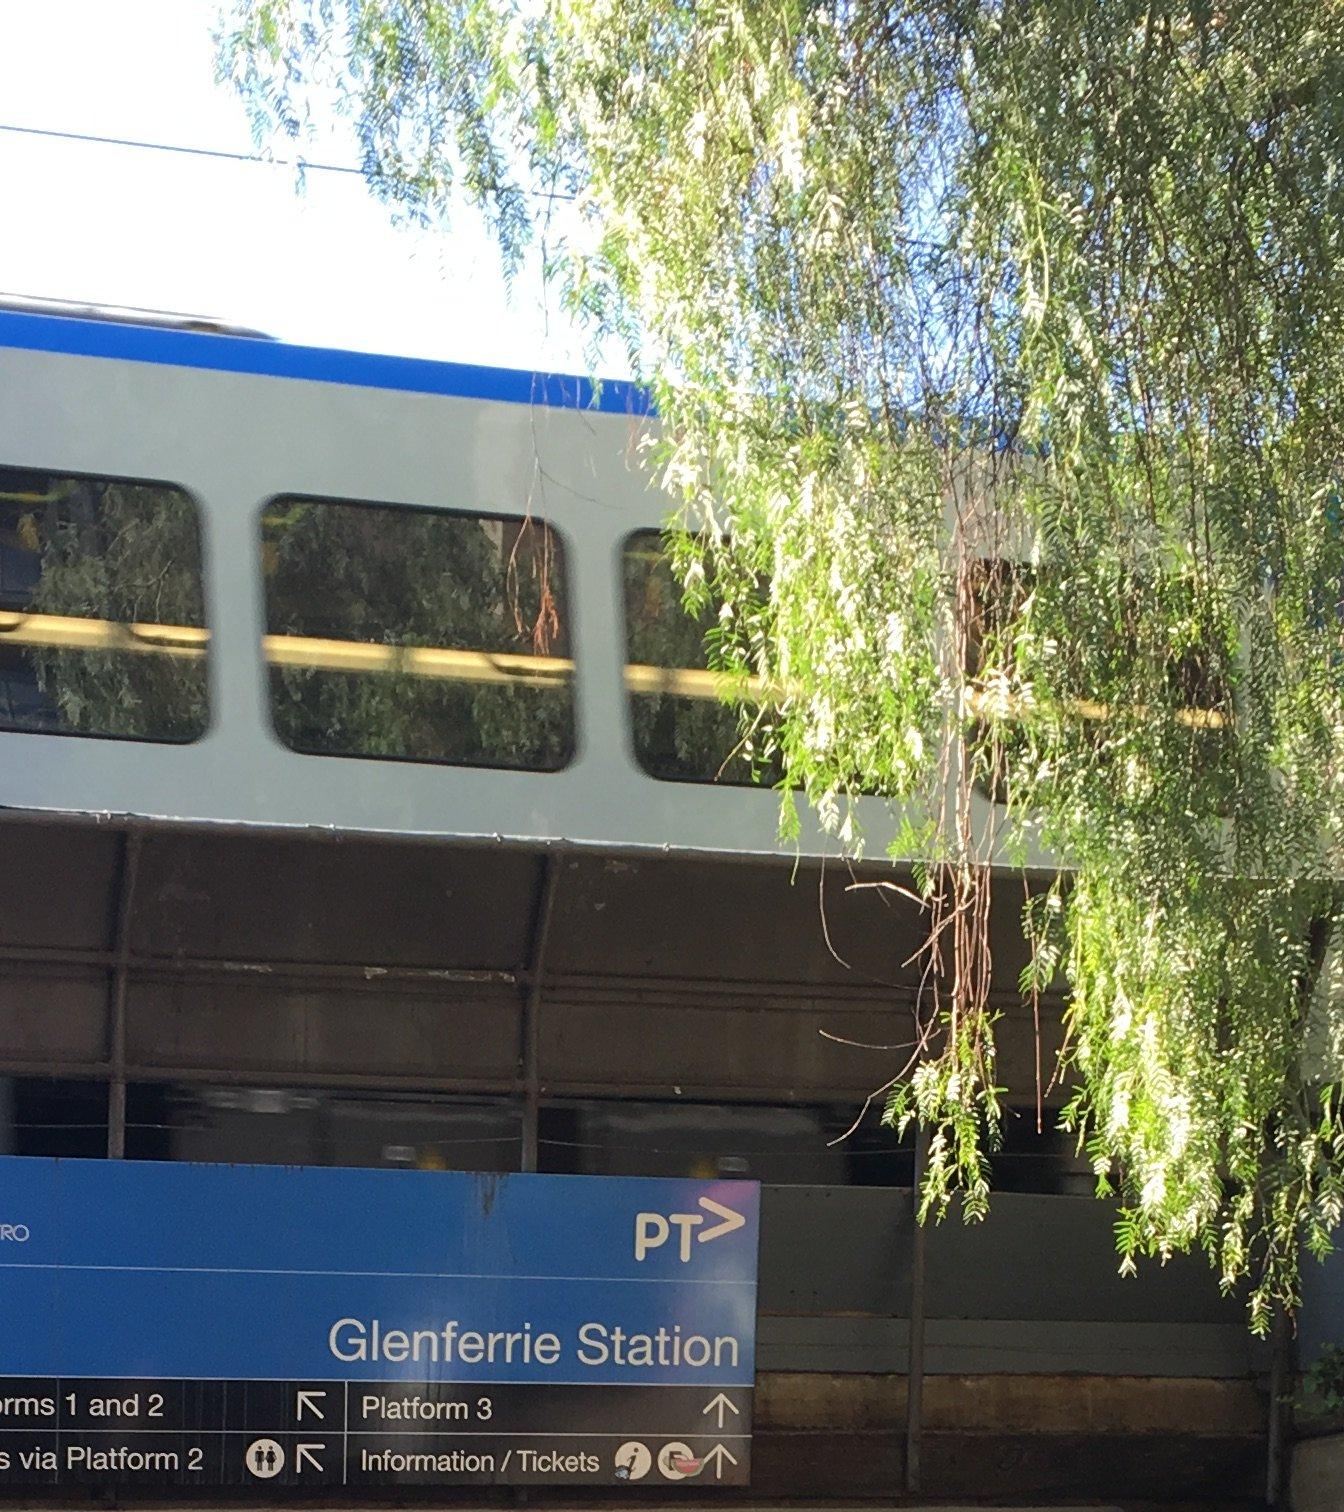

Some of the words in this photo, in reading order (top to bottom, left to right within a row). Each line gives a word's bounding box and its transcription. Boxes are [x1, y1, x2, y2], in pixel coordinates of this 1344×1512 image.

[329, 1318, 561, 1366] Glenferrie
[577, 1322, 738, 1367] Station
[65, 1394, 77, 1416] 1
[89, 1394, 139, 1417] and
[148, 1394, 164, 1417] 2
[362, 1396, 468, 1421] Platform
[477, 1398, 493, 1421] 3
[19, 1447, 57, 1470] via
[67, 1446, 179, 1471] Platform
[188, 1448, 204, 1471] 2
[361, 1449, 495, 1473] Information
[516, 1450, 600, 1473] Tickets
